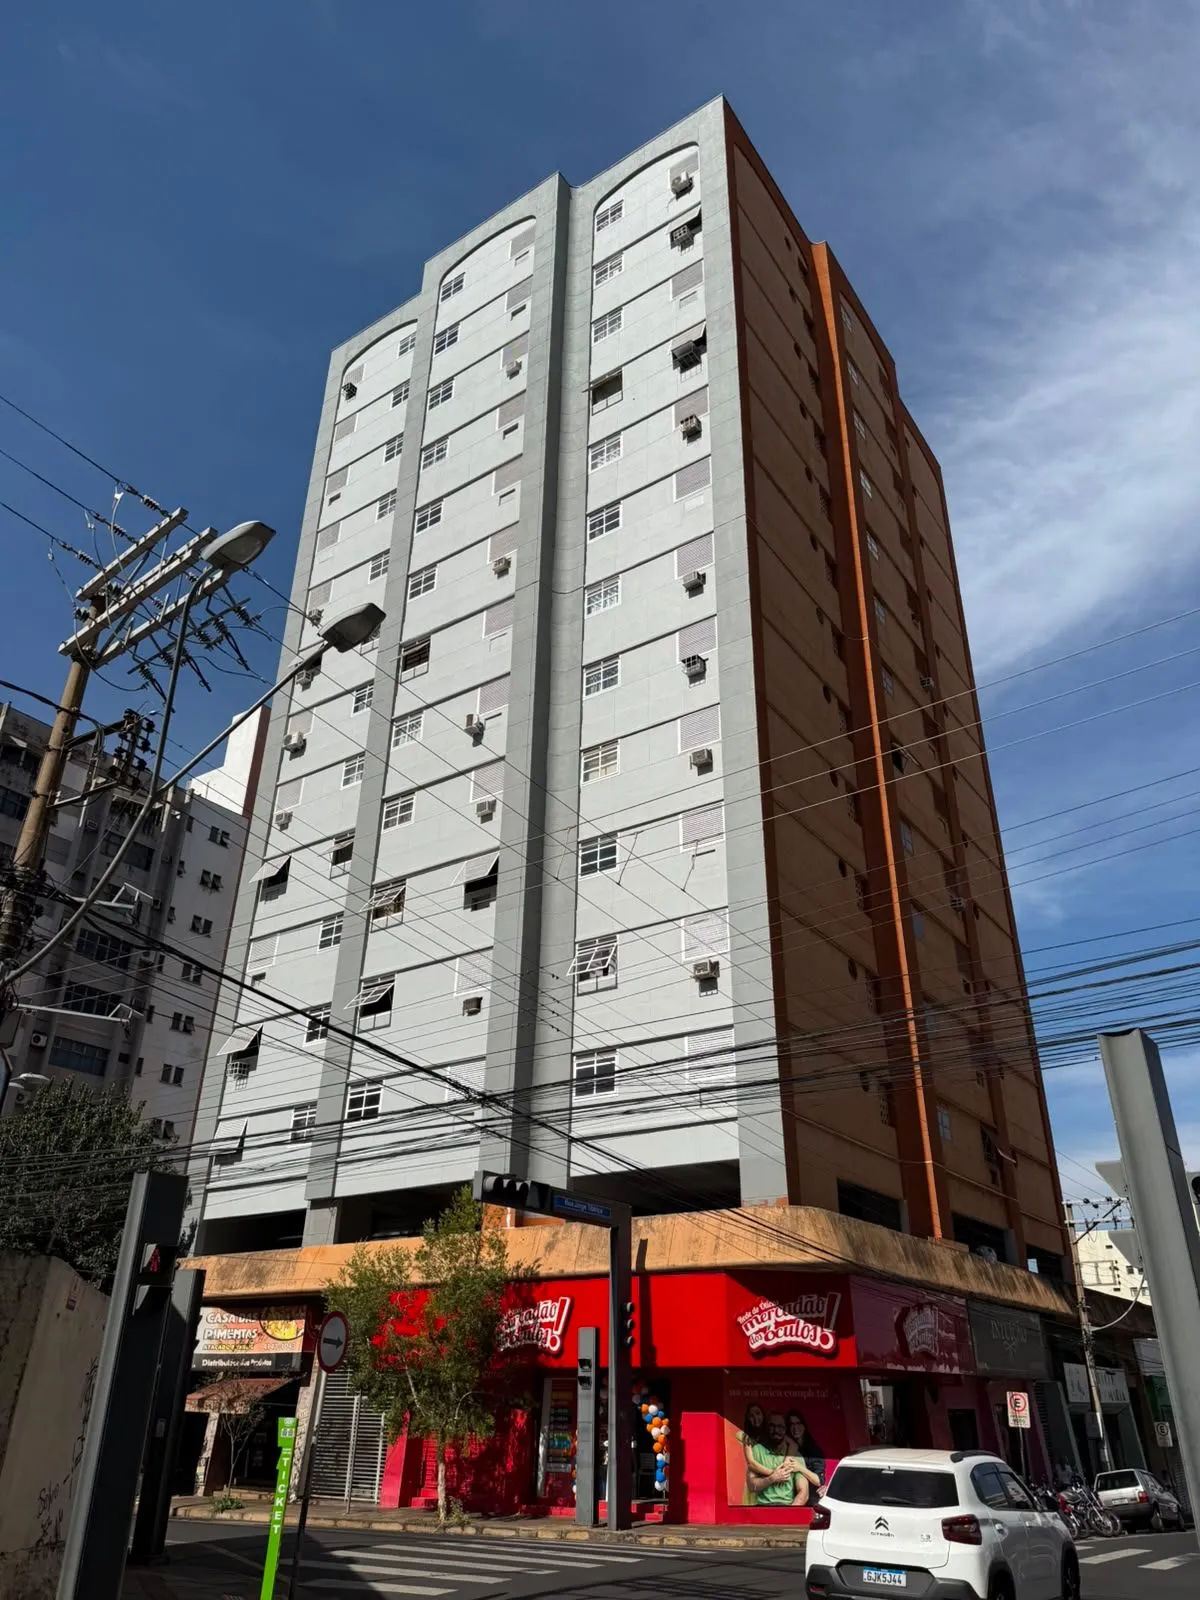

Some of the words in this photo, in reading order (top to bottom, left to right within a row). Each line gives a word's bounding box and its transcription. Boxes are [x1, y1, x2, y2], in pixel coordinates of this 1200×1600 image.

[206, 1312, 237, 1324] CASA
[239, 1312, 257, 1323] DAS
[203, 1328, 257, 1341] PIMENTAS
[1014, 1398, 1021, 1408] E
[272, 1458, 290, 1533] TICKET
[866, 1571, 902, 1585] GJK5J44
